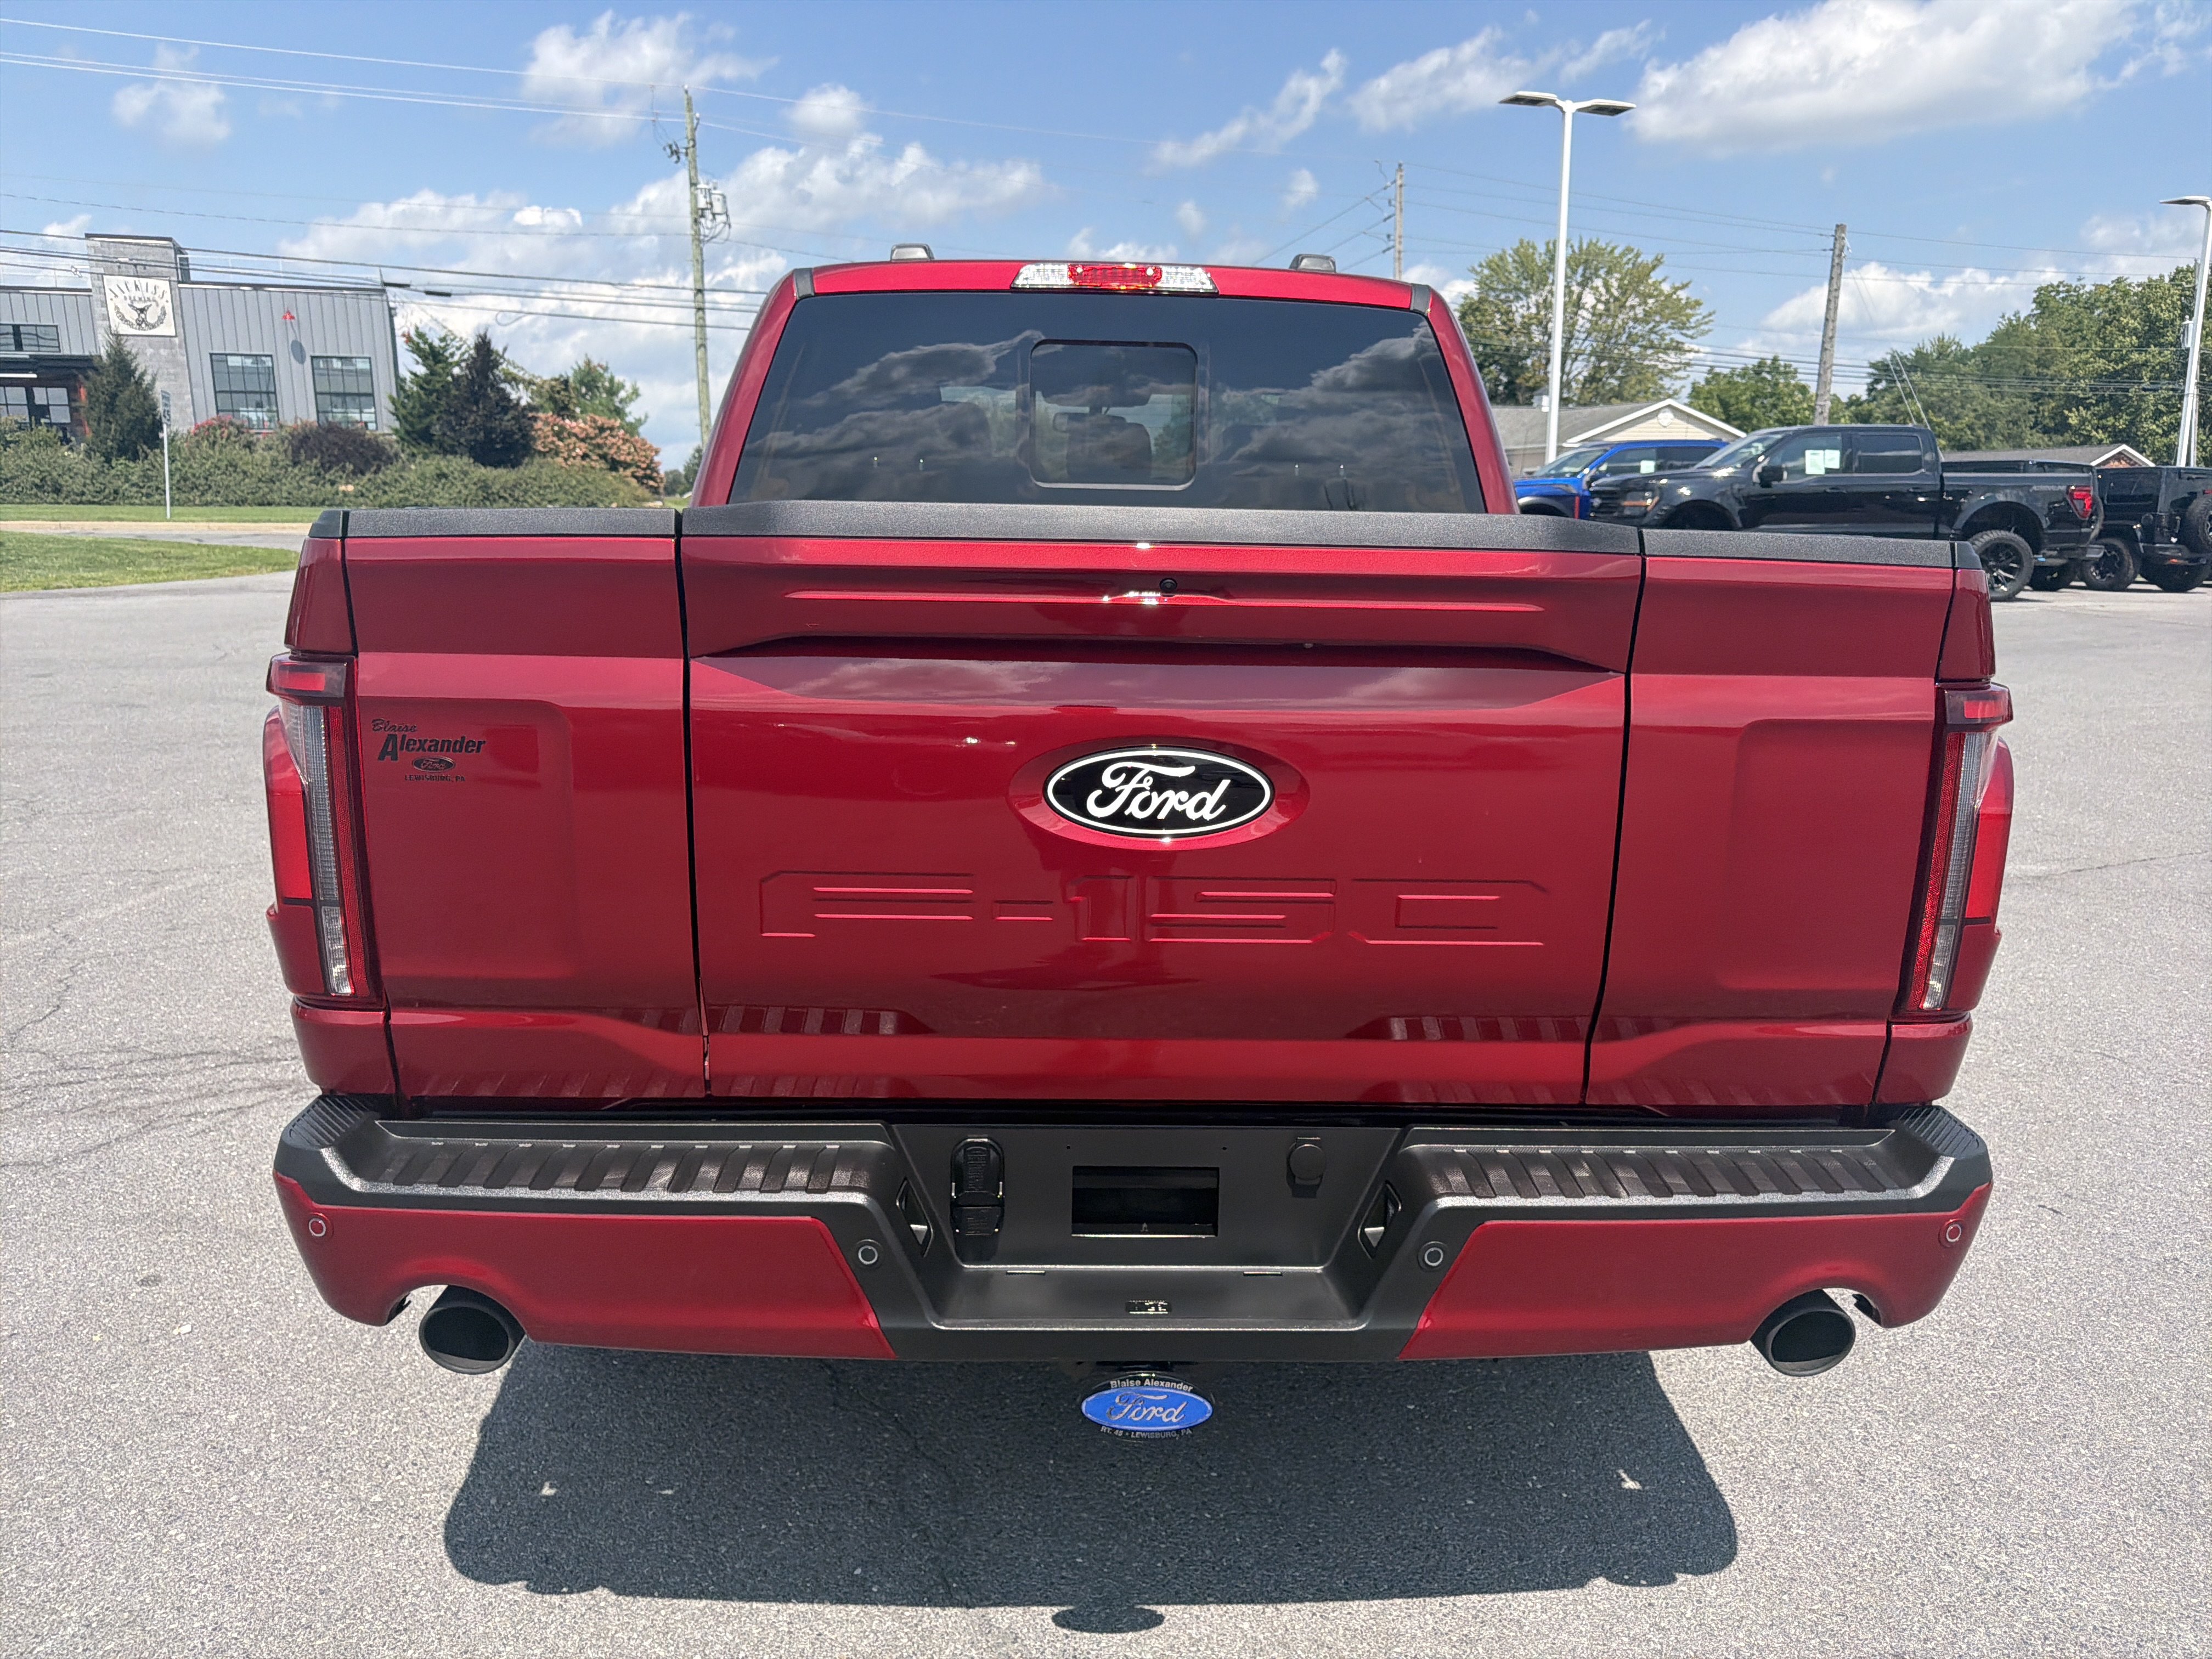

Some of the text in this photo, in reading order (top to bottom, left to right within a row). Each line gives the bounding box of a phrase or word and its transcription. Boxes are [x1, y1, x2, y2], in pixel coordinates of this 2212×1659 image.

[371, 718, 417, 732] Blaise
[377, 733, 486, 762] Alexander
[1086, 761, 1231, 820] Ford
[760, 870, 1549, 946] F-150
[1110, 1378, 1193, 1392] Blaise Alexander
[1106, 1391, 1189, 1423] Ford
[1101, 1426, 1112, 1434] RT.
[1181, 1427, 1192, 1436] PA
